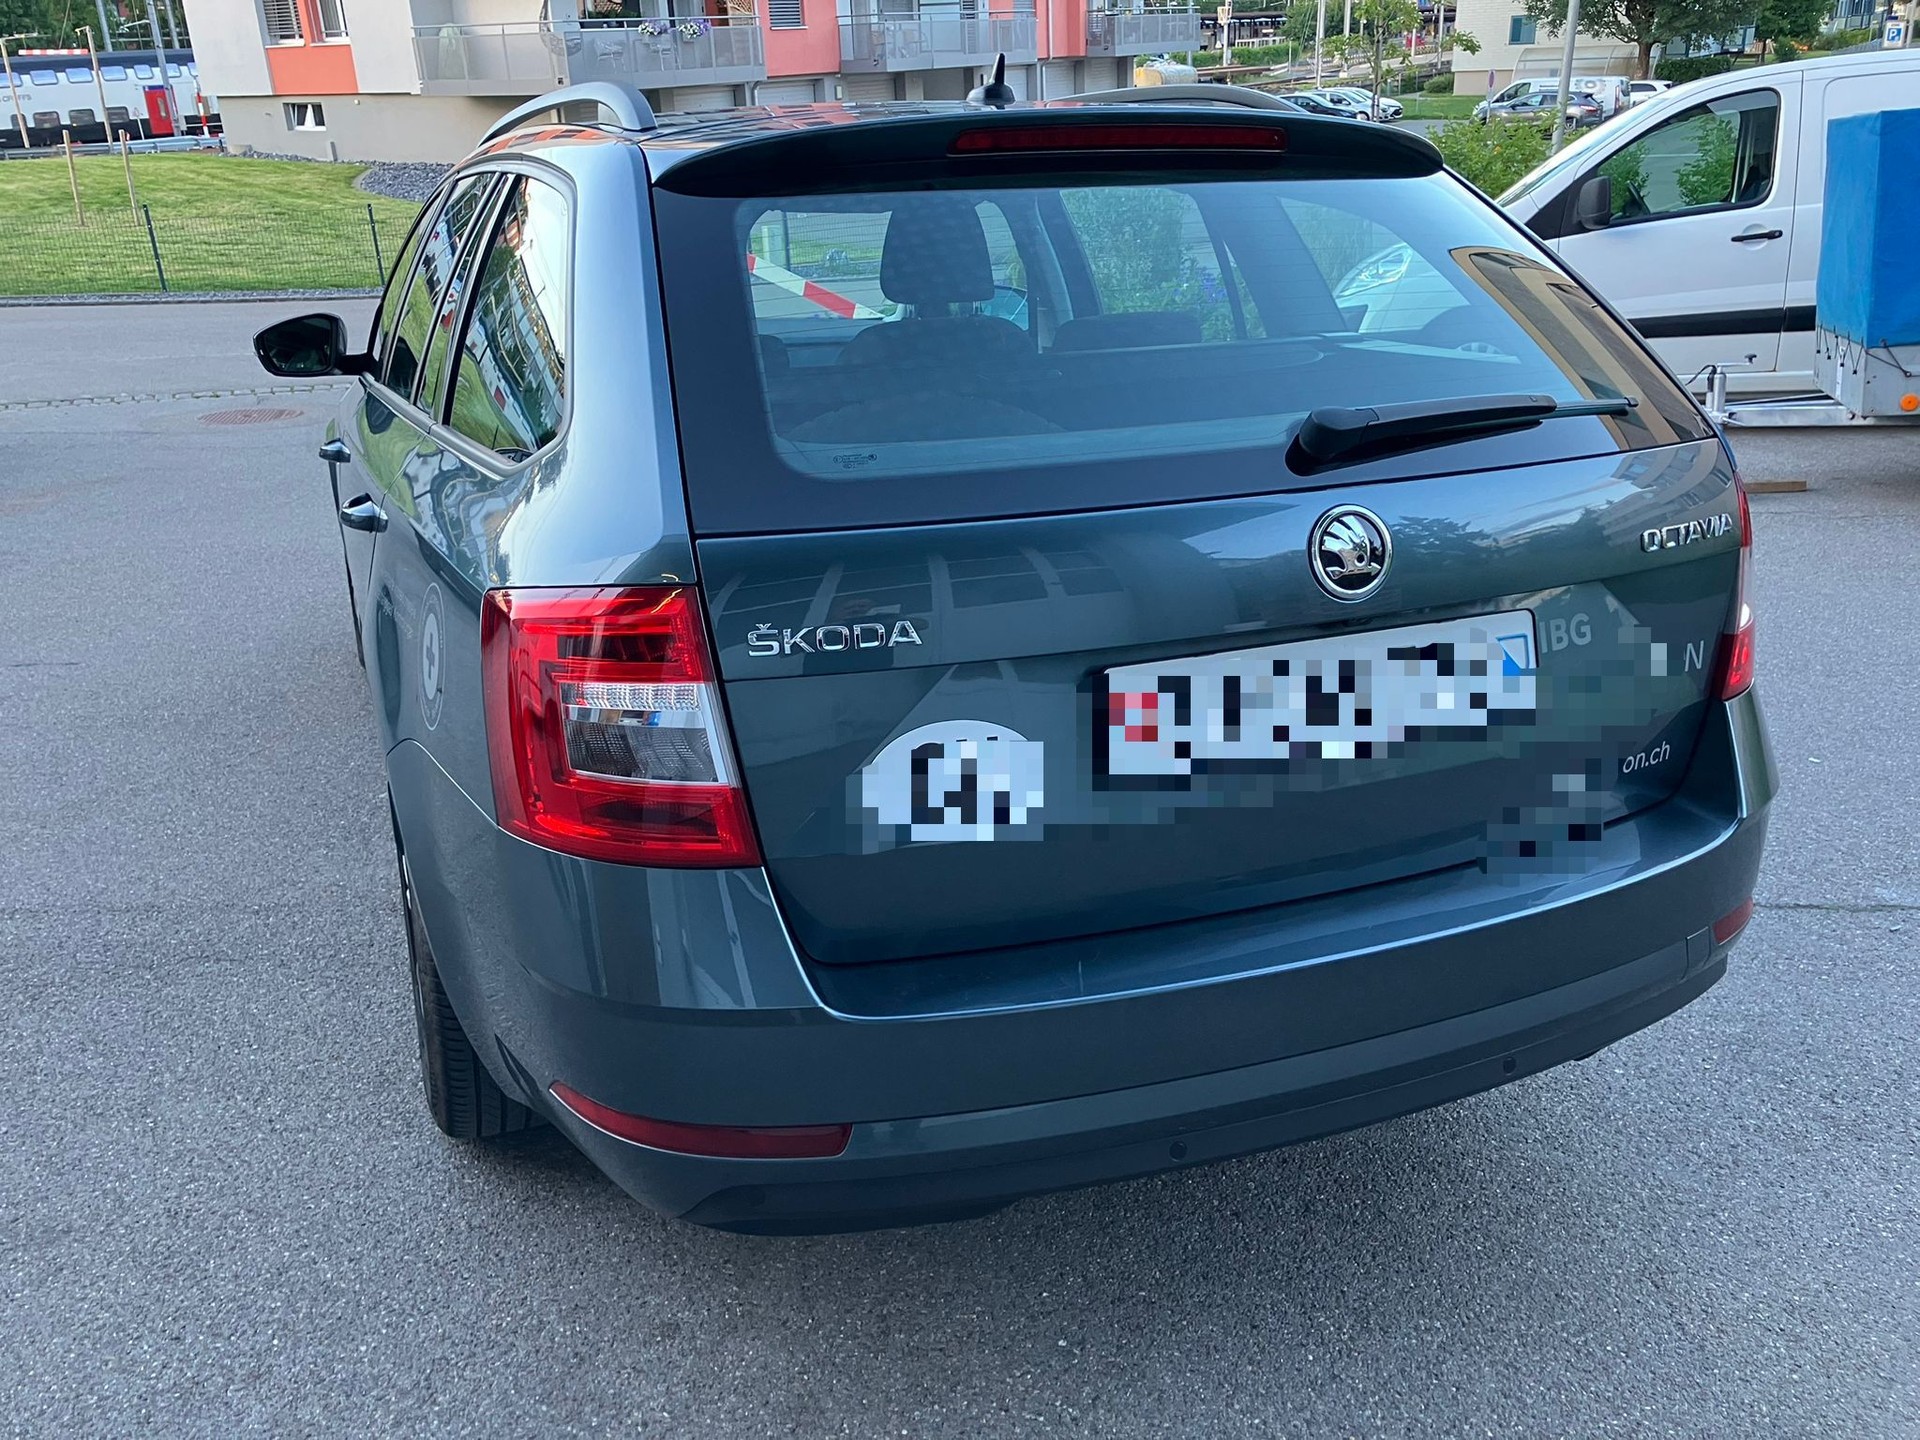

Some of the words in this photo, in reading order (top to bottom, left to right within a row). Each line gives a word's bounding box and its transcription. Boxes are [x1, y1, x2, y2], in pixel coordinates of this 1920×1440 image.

[1641, 513, 1733, 552] OCTAVIA
[747, 620, 923, 657] ŠKODA
[1540, 612, 1592, 654] IBG
